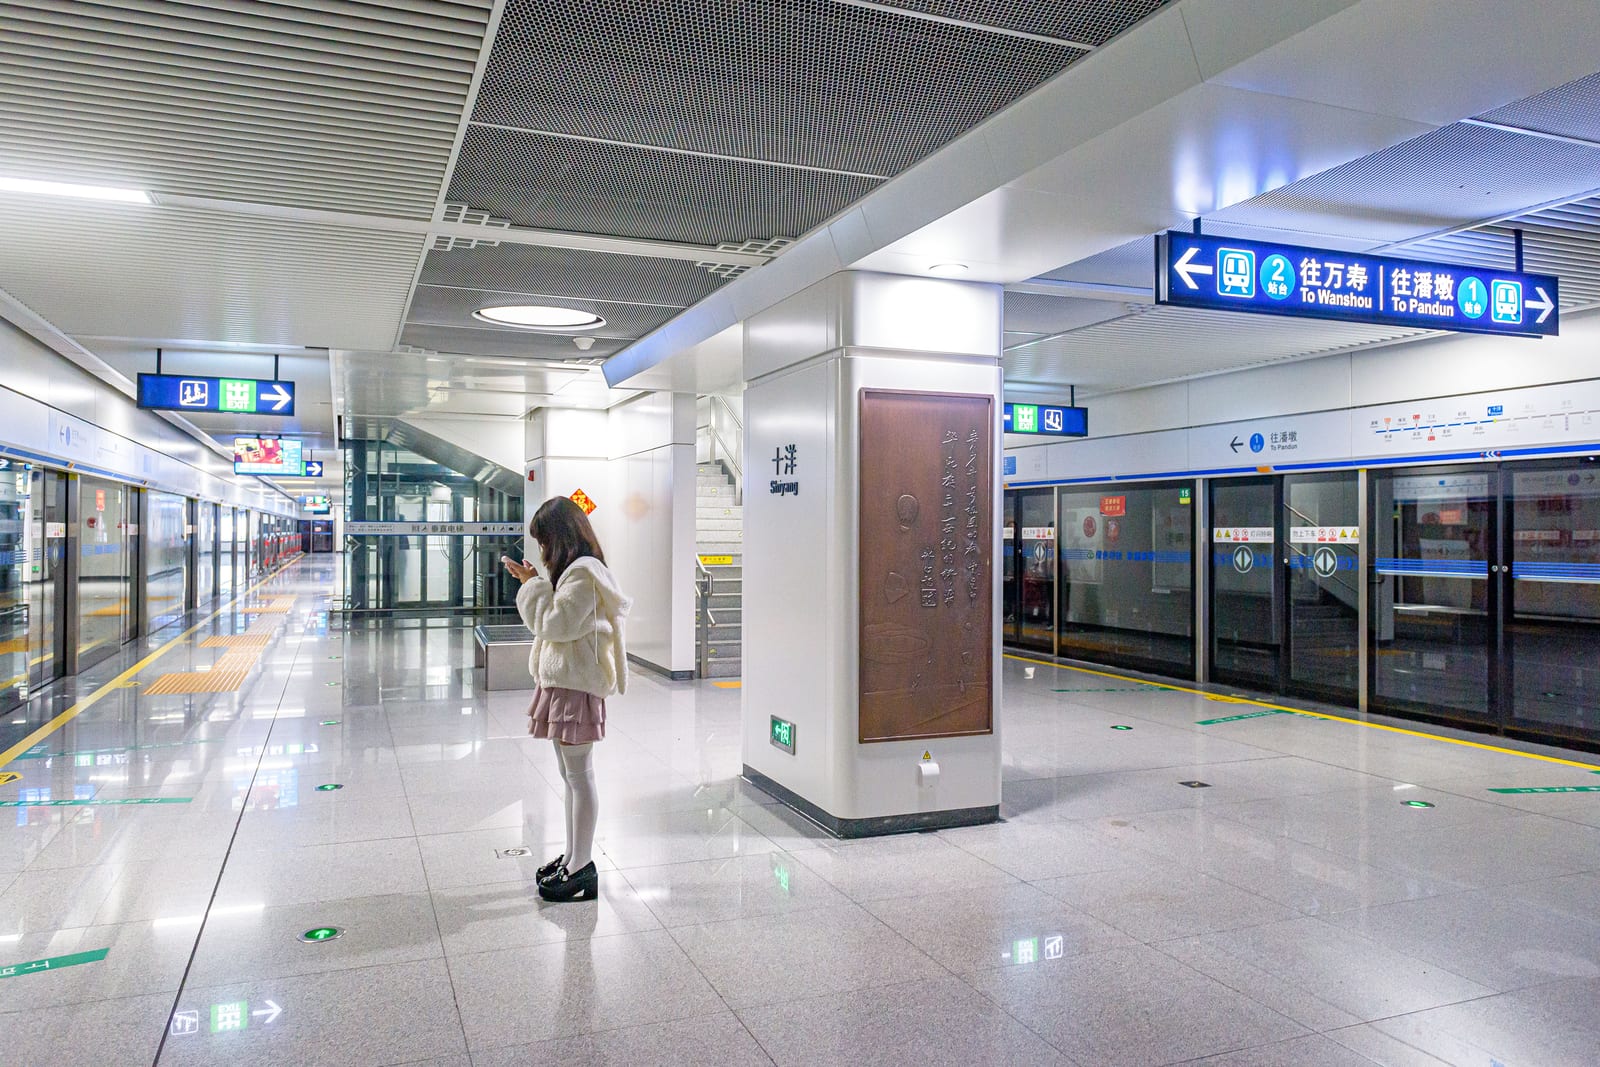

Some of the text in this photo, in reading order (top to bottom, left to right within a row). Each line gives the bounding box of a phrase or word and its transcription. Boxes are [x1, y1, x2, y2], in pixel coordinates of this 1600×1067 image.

[1271, 257, 1286, 281] 2
[1300, 257, 1368, 289] 往万寿
[1267, 281, 1289, 296] 站台
[1391, 267, 1455, 302] 往潘墩
[1468, 280, 1478, 298] 1
[1301, 286, 1373, 309] To Wanshou
[1391, 296, 1455, 317] To Pandun
[1463, 300, 1483, 315] 站台
[226, 400, 249, 409] EXIT
[1018, 422, 1033, 430] EXIT
[1270, 431, 1297, 443] 往潘墩
[771, 444, 797, 475] 十洋
[1181, 489, 1189, 498] 15
